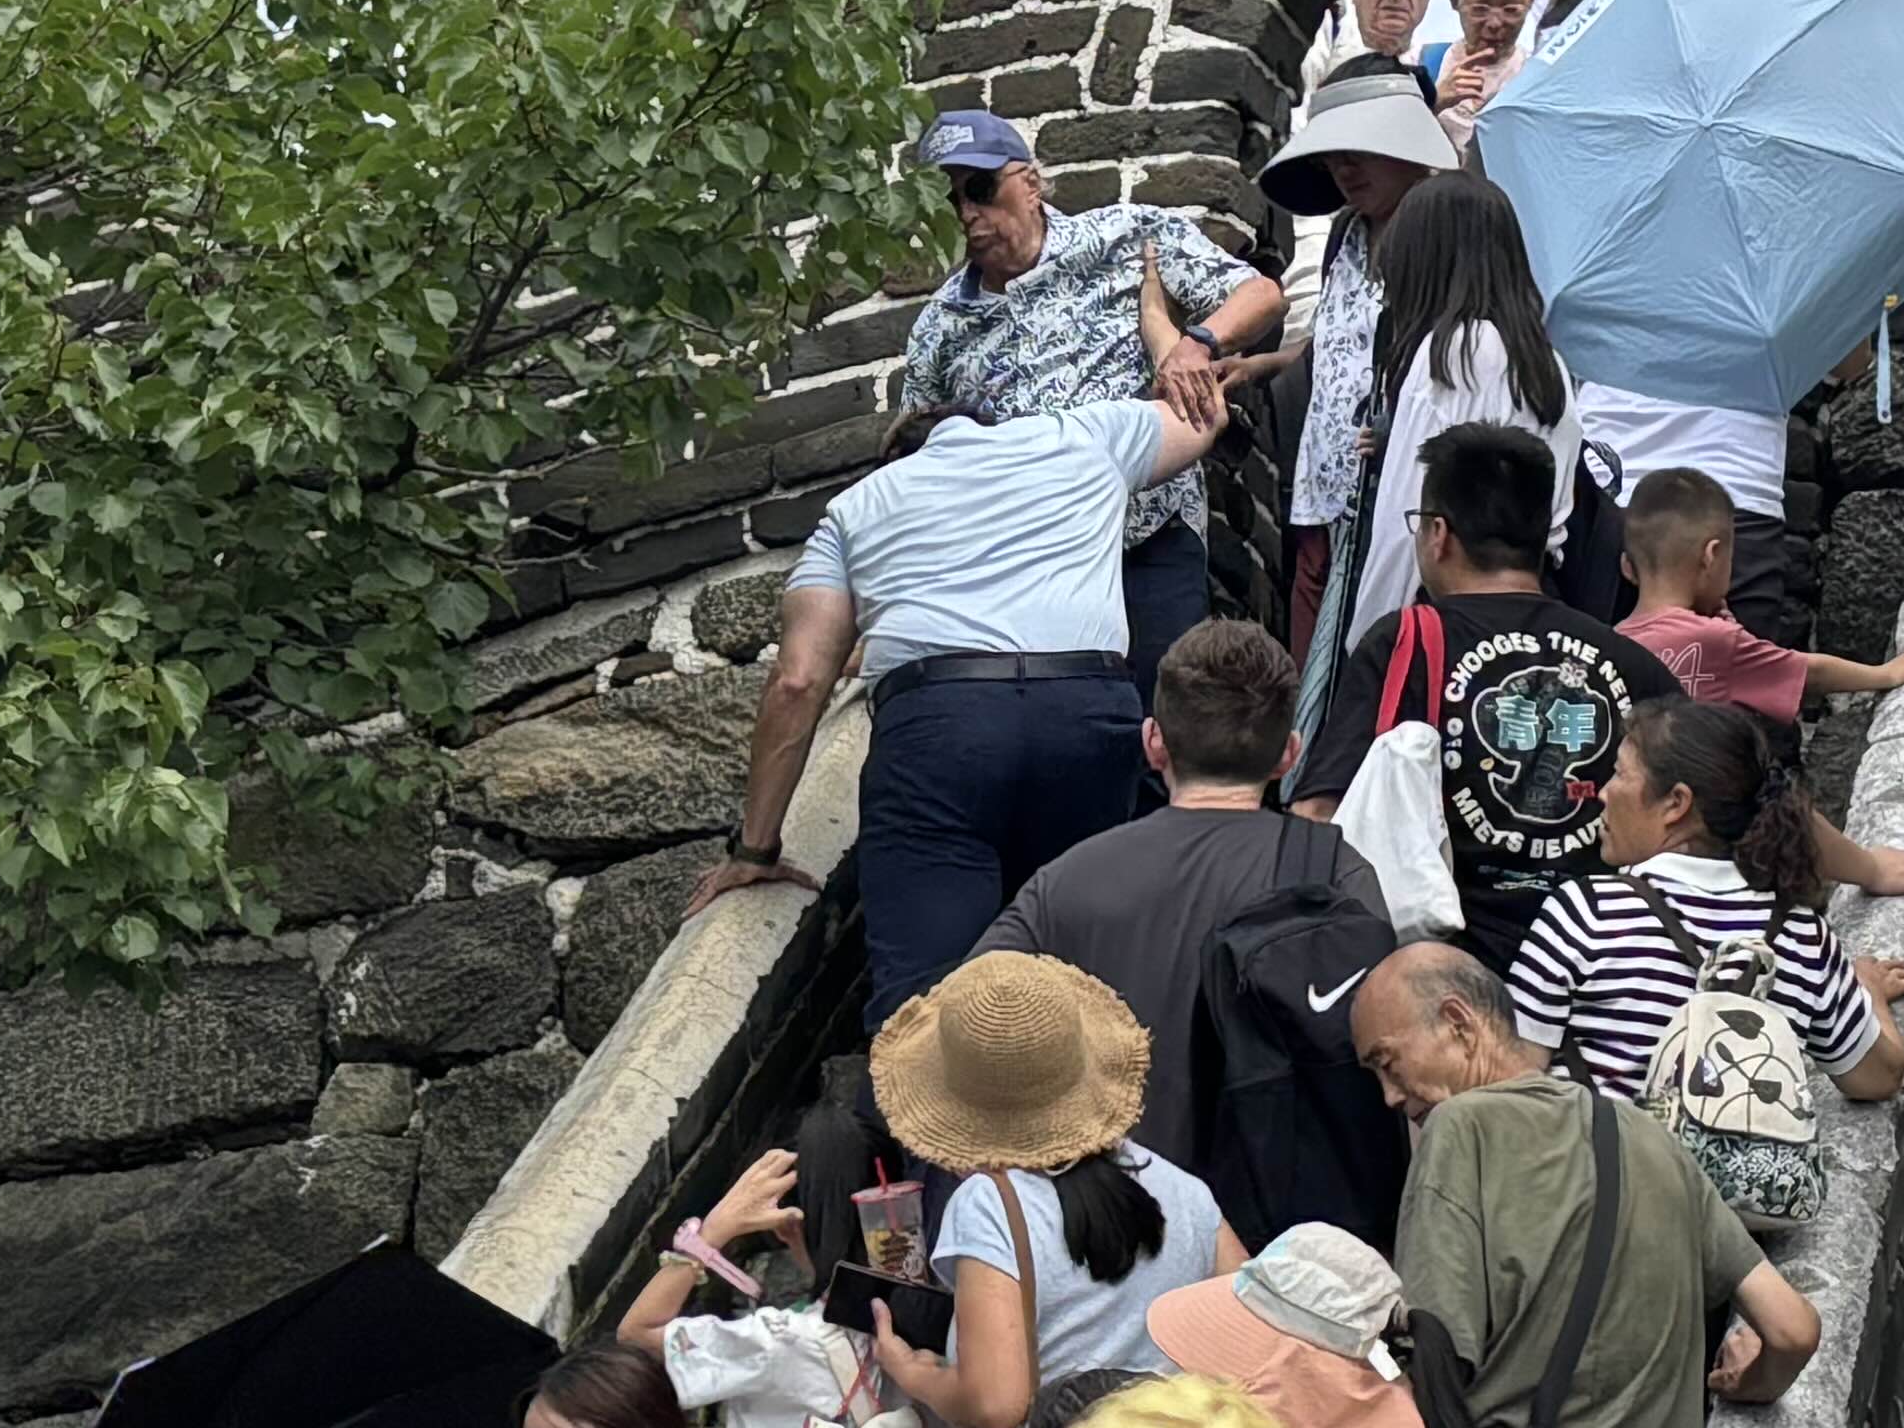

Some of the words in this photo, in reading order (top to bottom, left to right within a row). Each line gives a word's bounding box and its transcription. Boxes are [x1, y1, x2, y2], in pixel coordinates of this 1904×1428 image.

[1547, 631, 1600, 665] THE
[1495, 694, 1598, 753] 青年
[1451, 786, 1526, 853] MEETS
